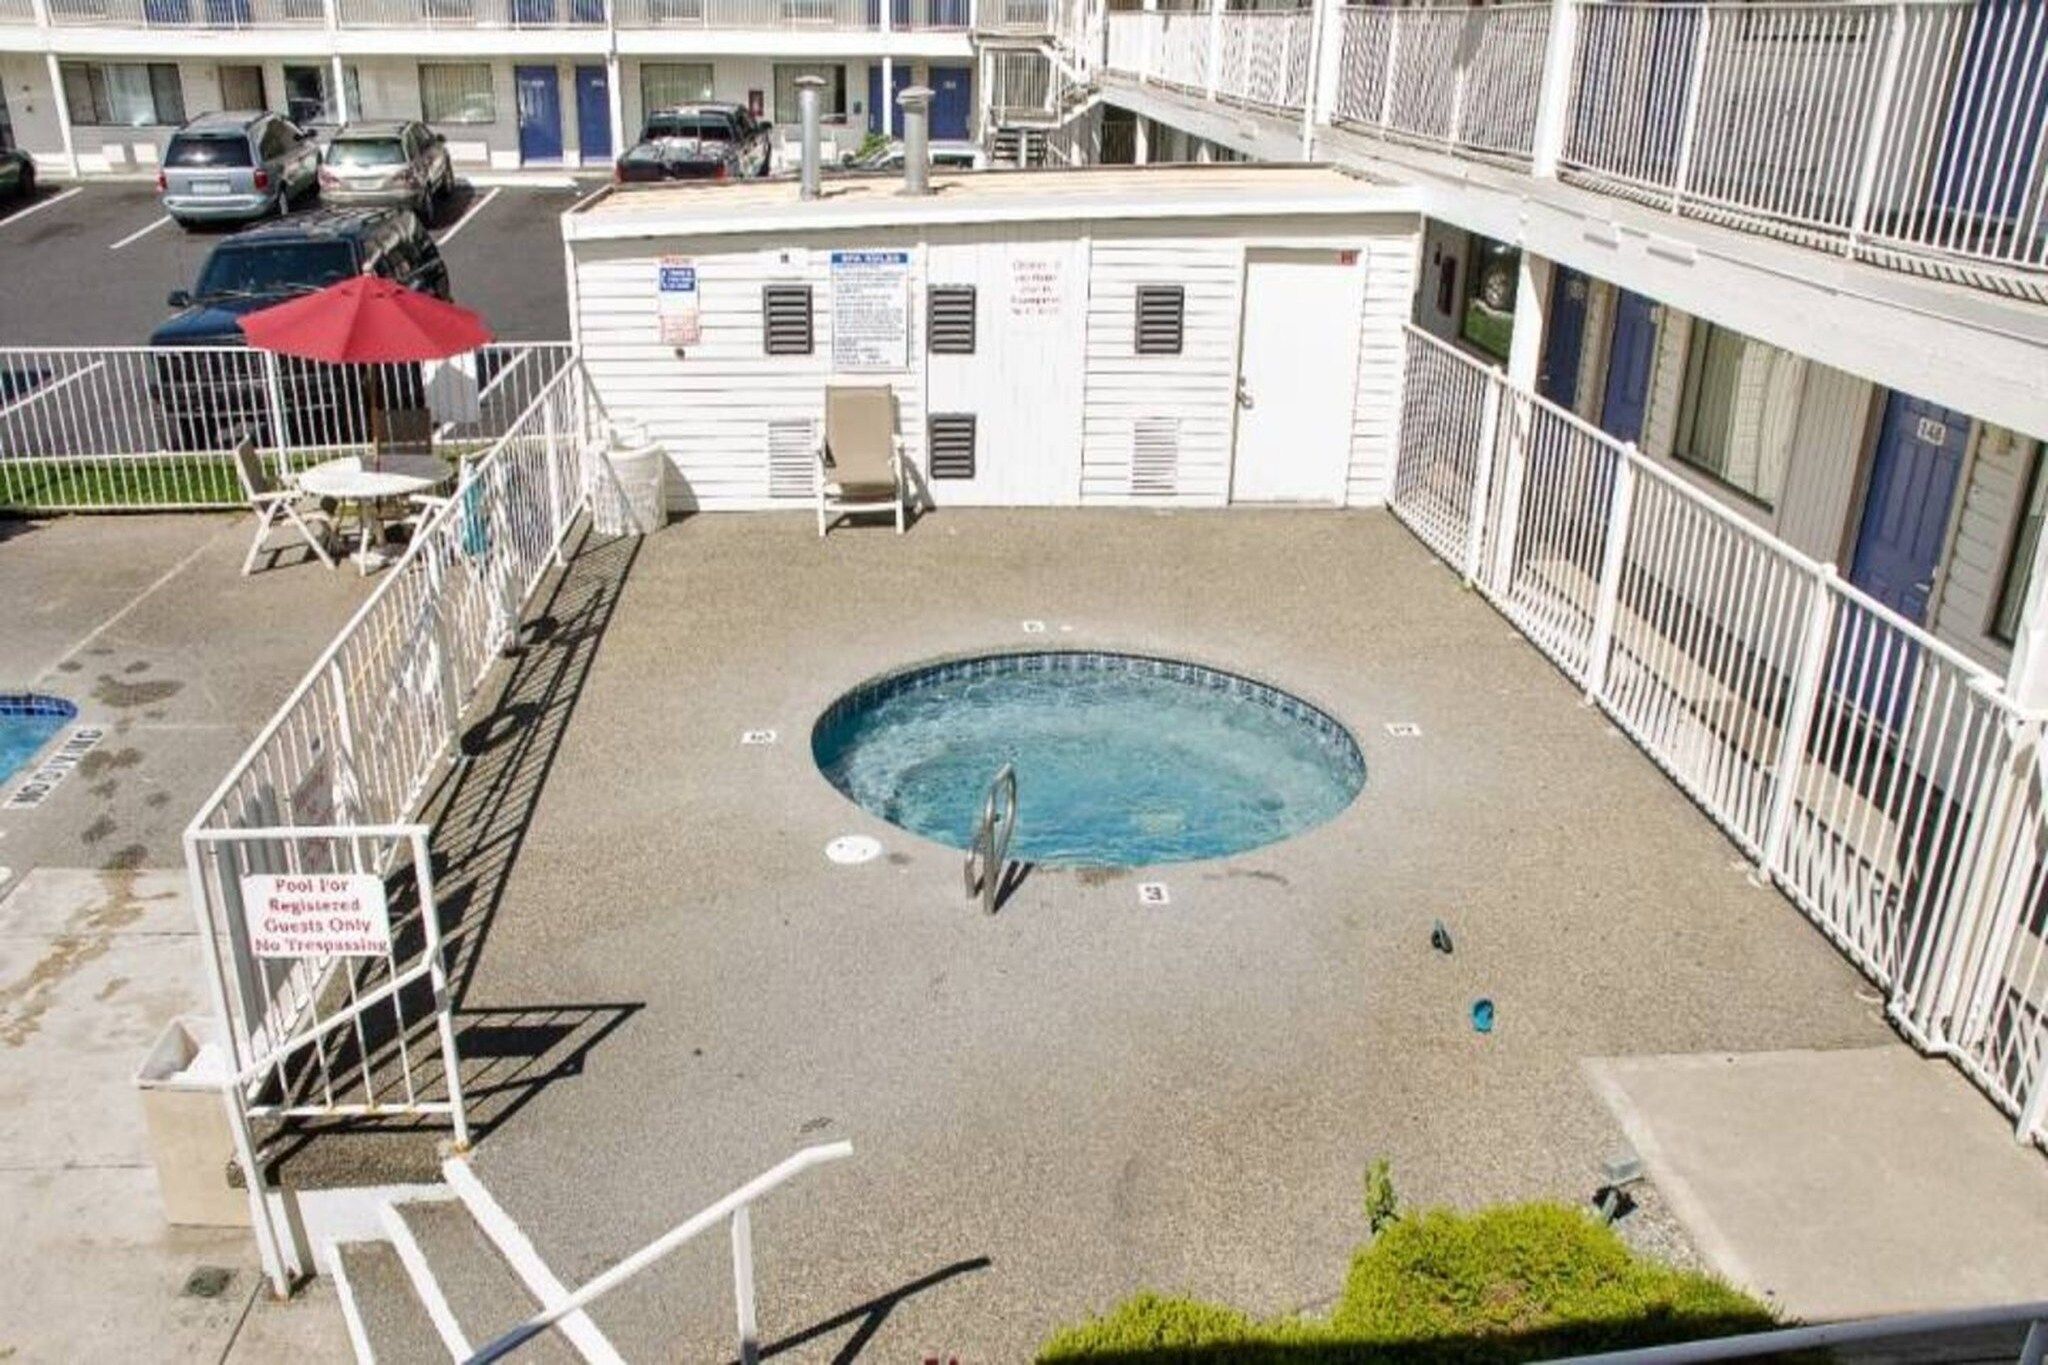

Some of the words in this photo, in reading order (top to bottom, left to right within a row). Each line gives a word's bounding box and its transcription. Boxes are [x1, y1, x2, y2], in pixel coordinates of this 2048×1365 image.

[275, 878, 313, 893] Pool
[320, 878, 349, 892] For
[269, 898, 360, 915] Registered
[264, 918, 323, 933] Guests
[329, 917, 371, 933] Only
[255, 938, 281, 951] No
[285, 939, 388, 954] Trespassing
